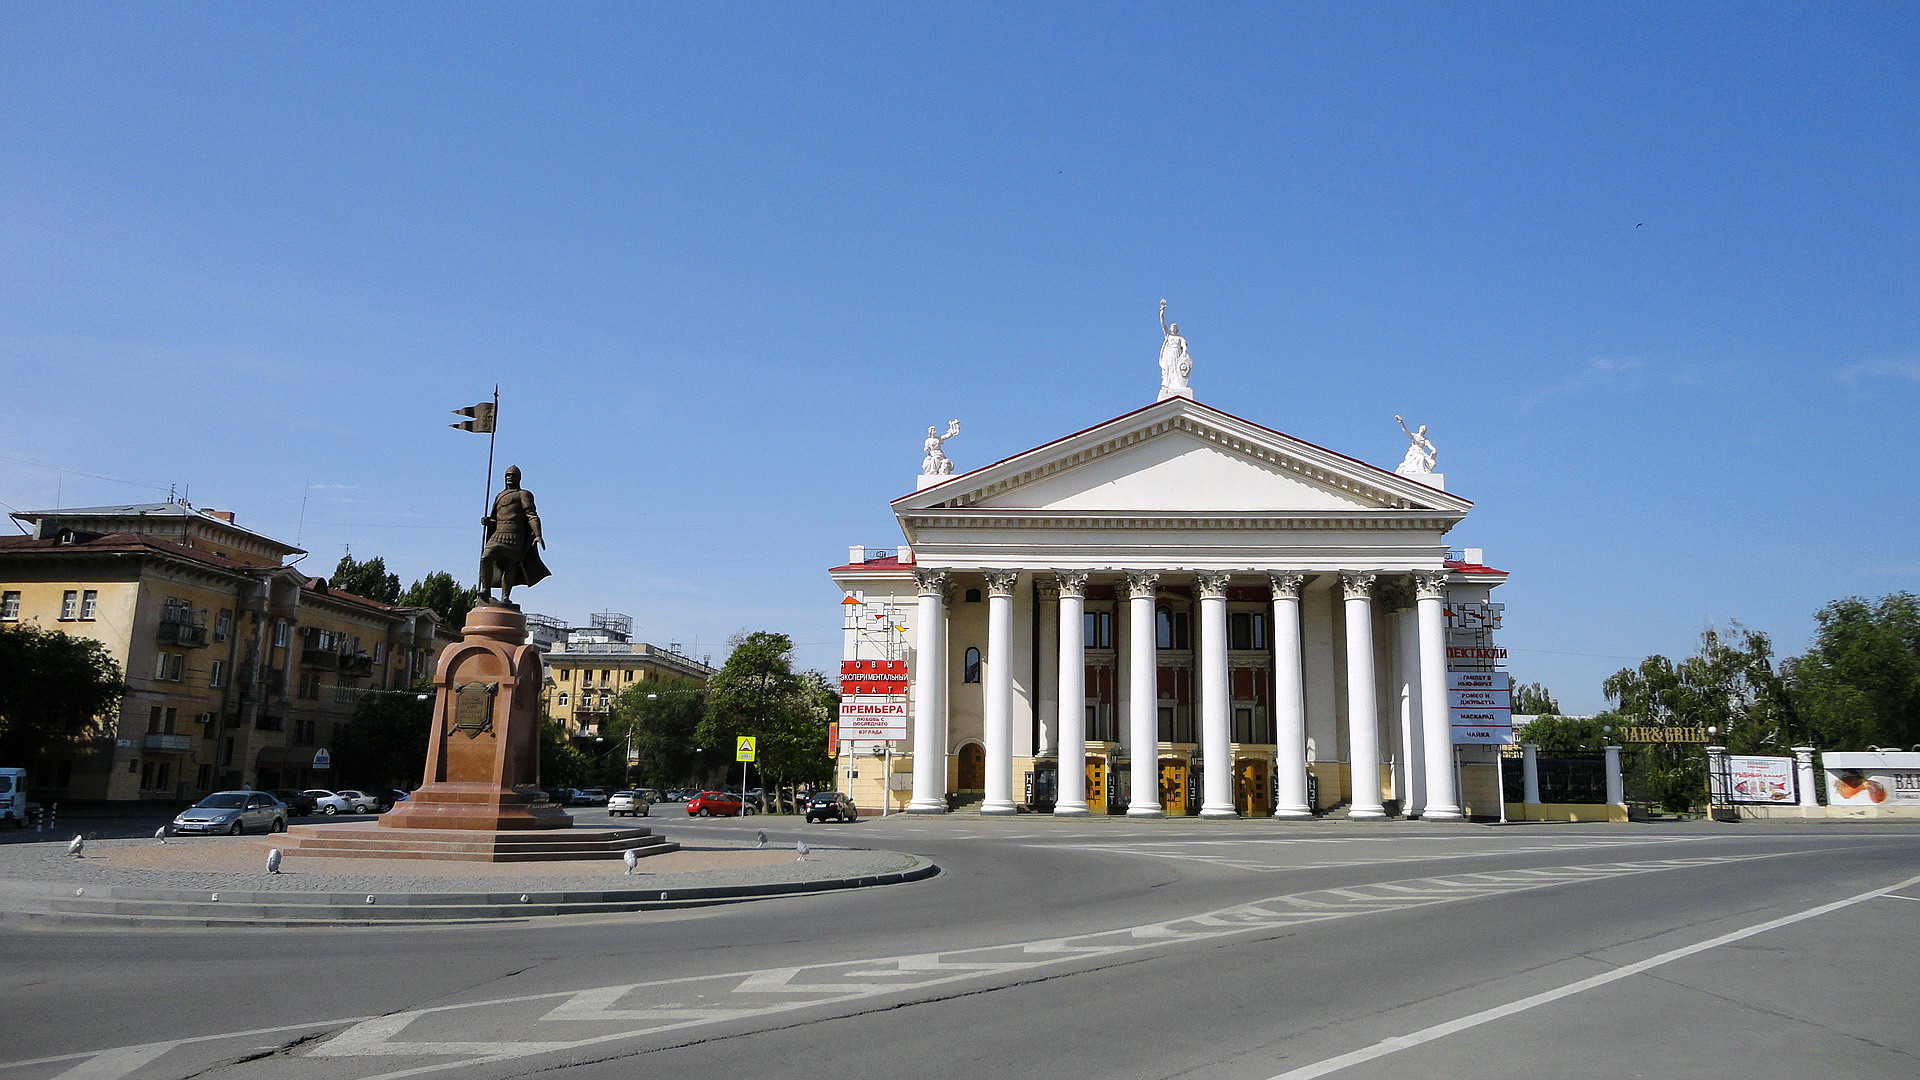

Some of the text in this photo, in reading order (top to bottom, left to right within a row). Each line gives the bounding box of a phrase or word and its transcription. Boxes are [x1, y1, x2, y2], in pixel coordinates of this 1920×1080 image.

[1446, 648, 1507, 658] ПЕКТАКЛИ
[840, 660, 909, 669] НОВЫЙ
[840, 673, 909, 681] ЭКСПЕРИМЕНТАЛЬНЫЙ
[840, 686, 909, 694] ТЕАТР
[841, 705, 904, 714] ПРЕМЬЕРА
